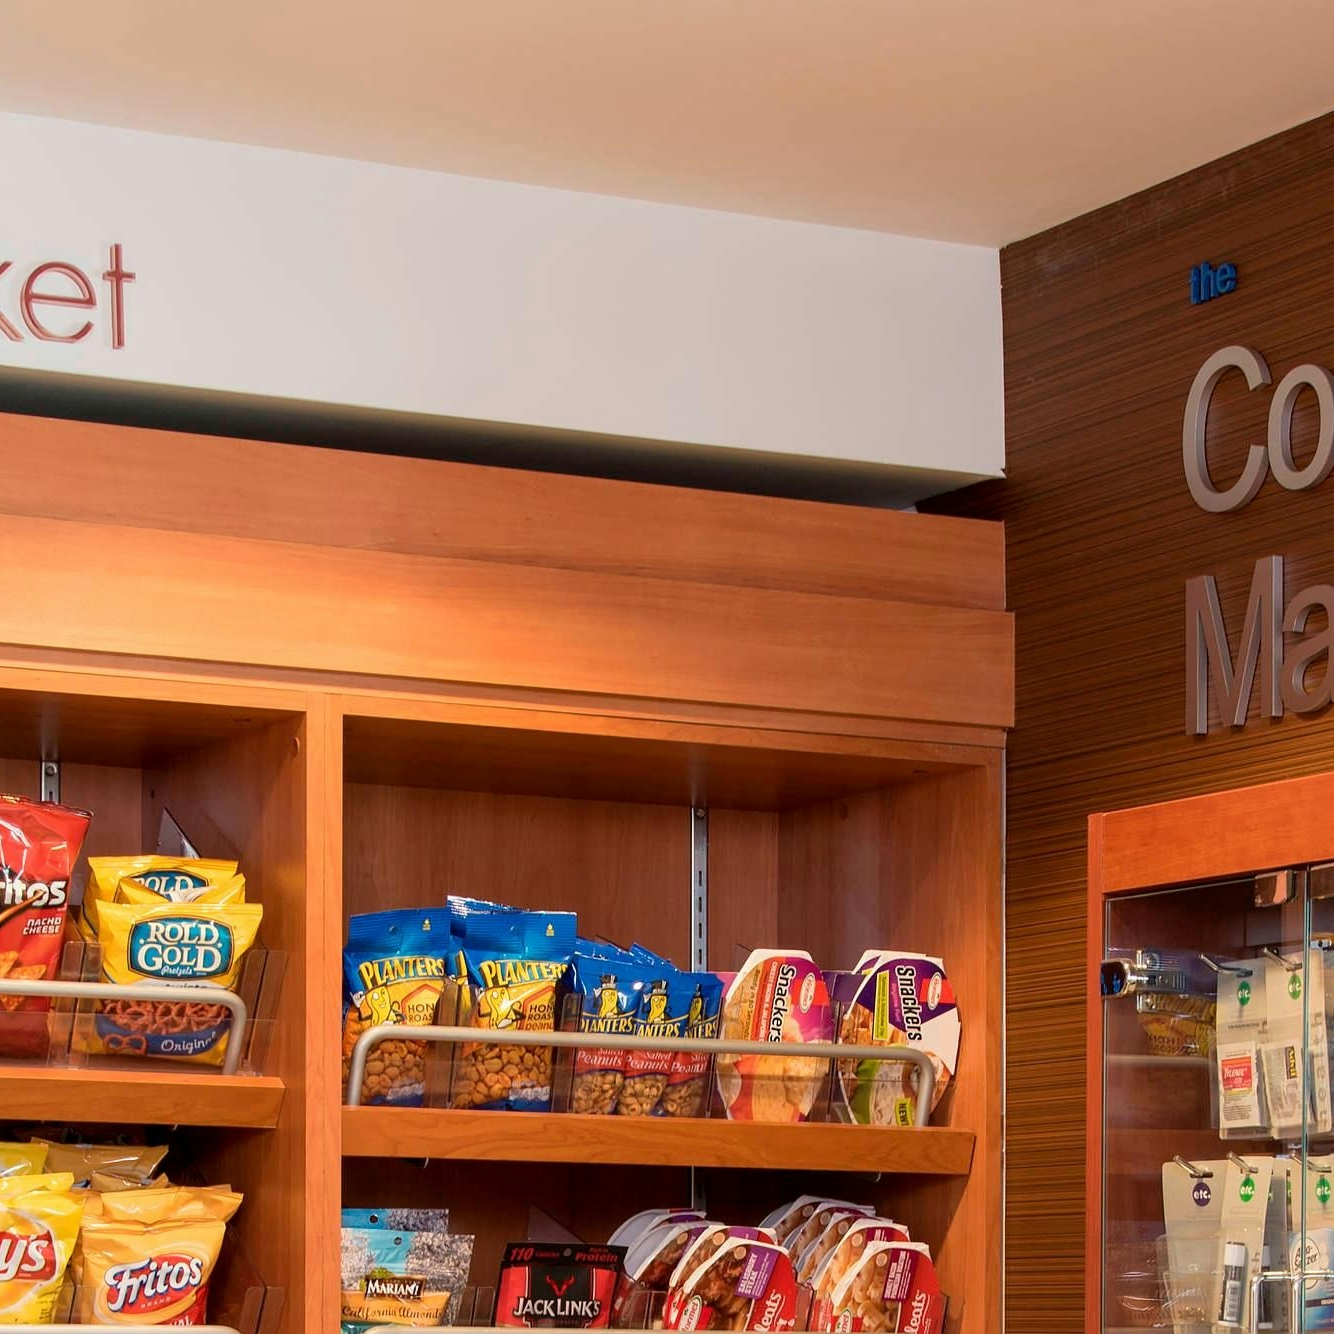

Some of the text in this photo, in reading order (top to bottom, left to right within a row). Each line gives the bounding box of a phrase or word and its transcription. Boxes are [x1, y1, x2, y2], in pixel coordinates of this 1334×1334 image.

[1189, 261, 1238, 304] the
[23, 926, 60, 935] CHEESE
[27, 918, 62, 926] NACHO
[148, 922, 218, 944] ROLD
[138, 945, 222, 972] GOLD
[359, 957, 445, 986] PLANTERS
[897, 966, 922, 1040] Snackers
[575, 1252, 619, 1262] Protein
[105, 1254, 205, 1313] Fritos
[342, 1305, 396, 1321] California
[513, 1298, 600, 1317] JACK LINK'S
